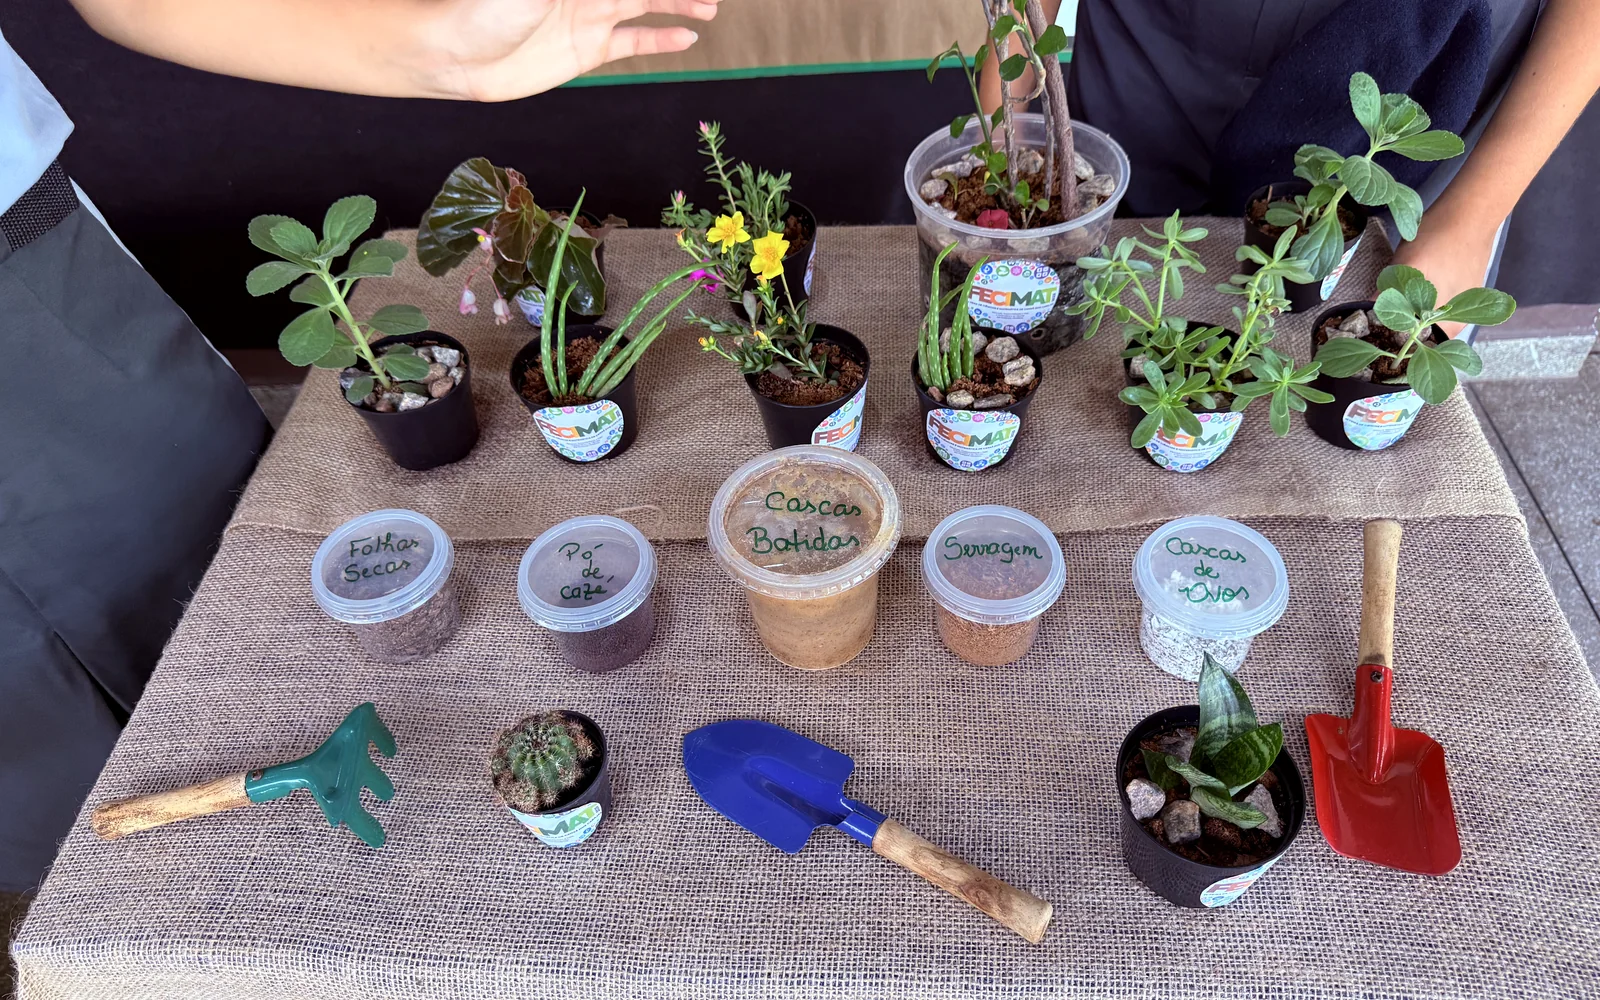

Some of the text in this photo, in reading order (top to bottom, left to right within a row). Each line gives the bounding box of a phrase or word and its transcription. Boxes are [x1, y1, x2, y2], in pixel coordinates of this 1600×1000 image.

[969, 285, 1058, 307] FECIMAT
[535, 406, 618, 439] FECIMAT
[928, 415, 1018, 447] FECIMAT
[765, 491, 862, 517] Cascas
[350, 532, 419, 557] Folhas
[558, 542, 604, 561] Pó
[745, 526, 861, 554] Batidas
[944, 536, 1043, 564] Serragem
[1165, 537, 1247, 563] Cascas
[344, 559, 411, 582] Secas
[582, 559, 604, 579] de
[1193, 559, 1220, 579] de
[1178, 582, 1250, 603] Ovos
